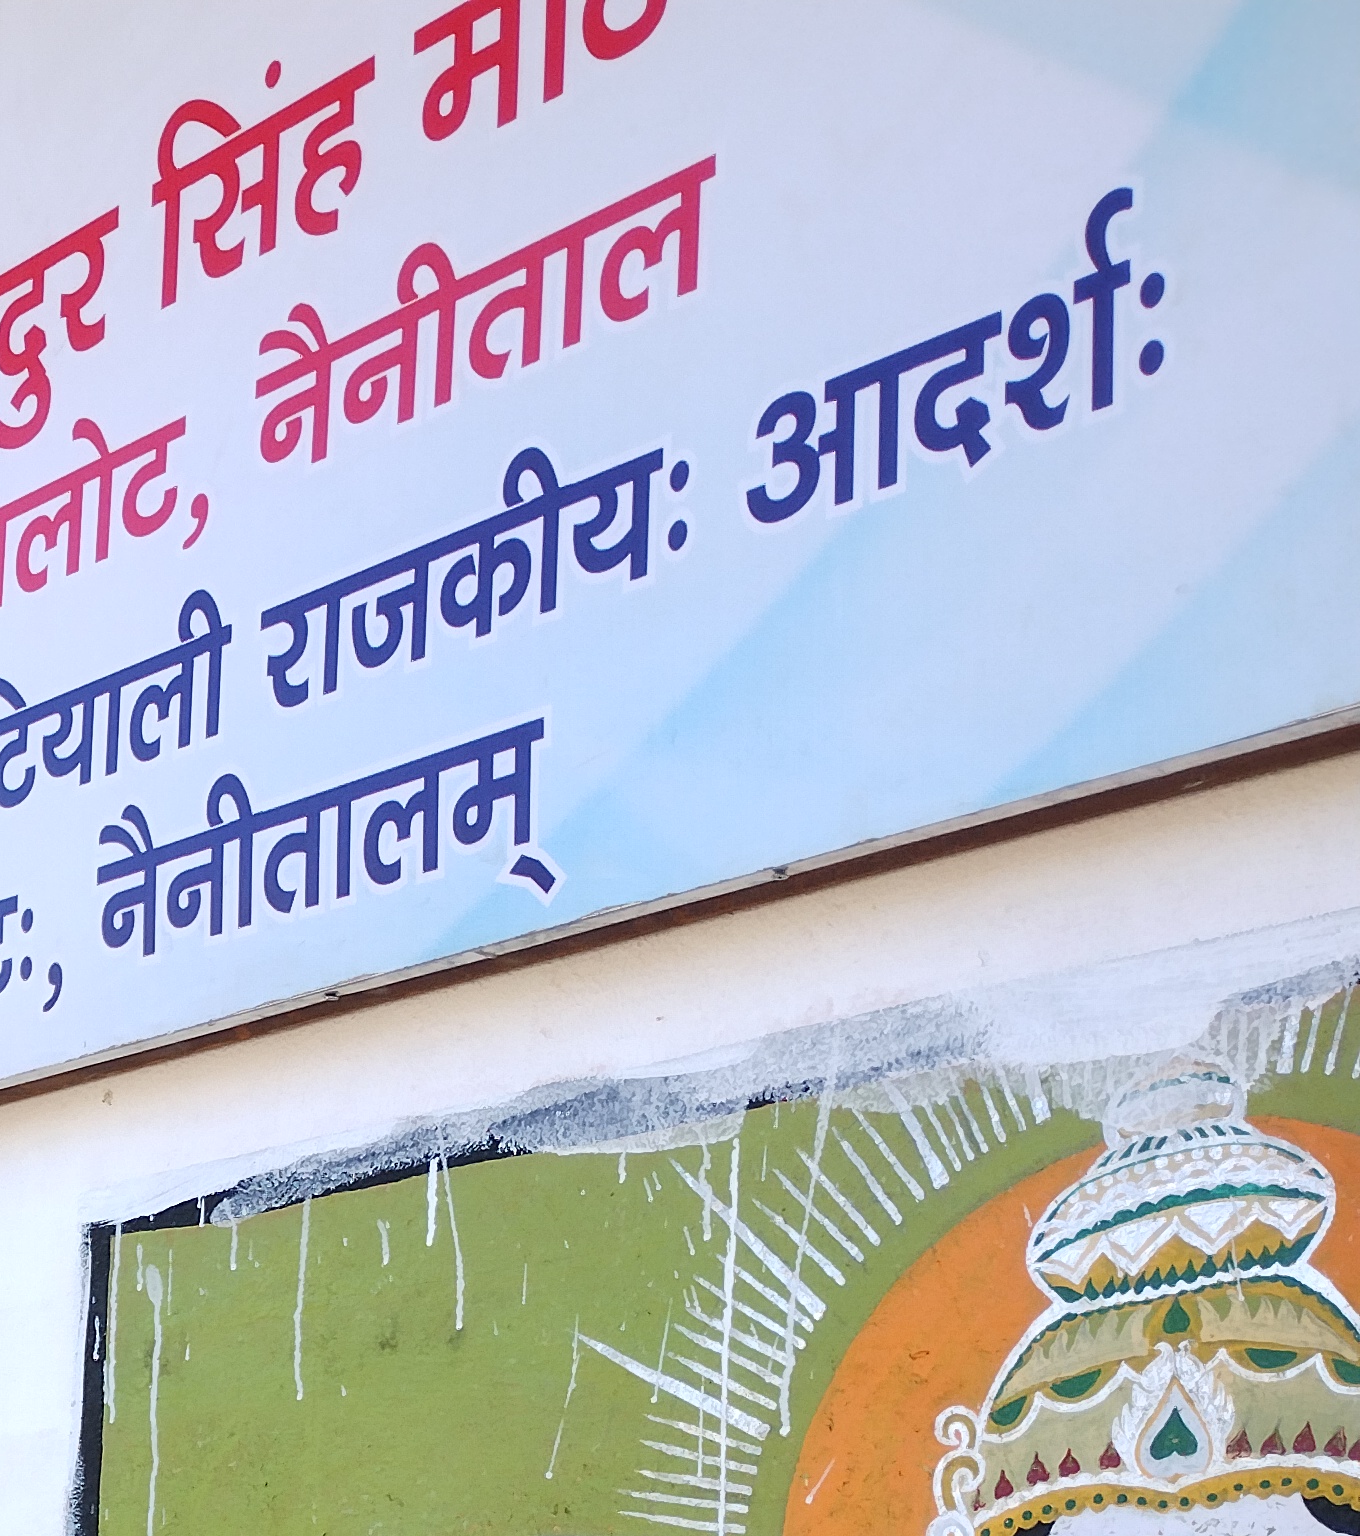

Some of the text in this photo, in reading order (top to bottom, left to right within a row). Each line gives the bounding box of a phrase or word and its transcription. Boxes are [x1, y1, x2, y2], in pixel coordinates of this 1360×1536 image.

[152, 60, 375, 309] सिंह
[256, 154, 716, 466] नैनीताल
[260, 447, 689, 709] राजकीयः
[746, 187, 1165, 524] आदर्शः
[97, 719, 559, 957] नैनीतालम्
